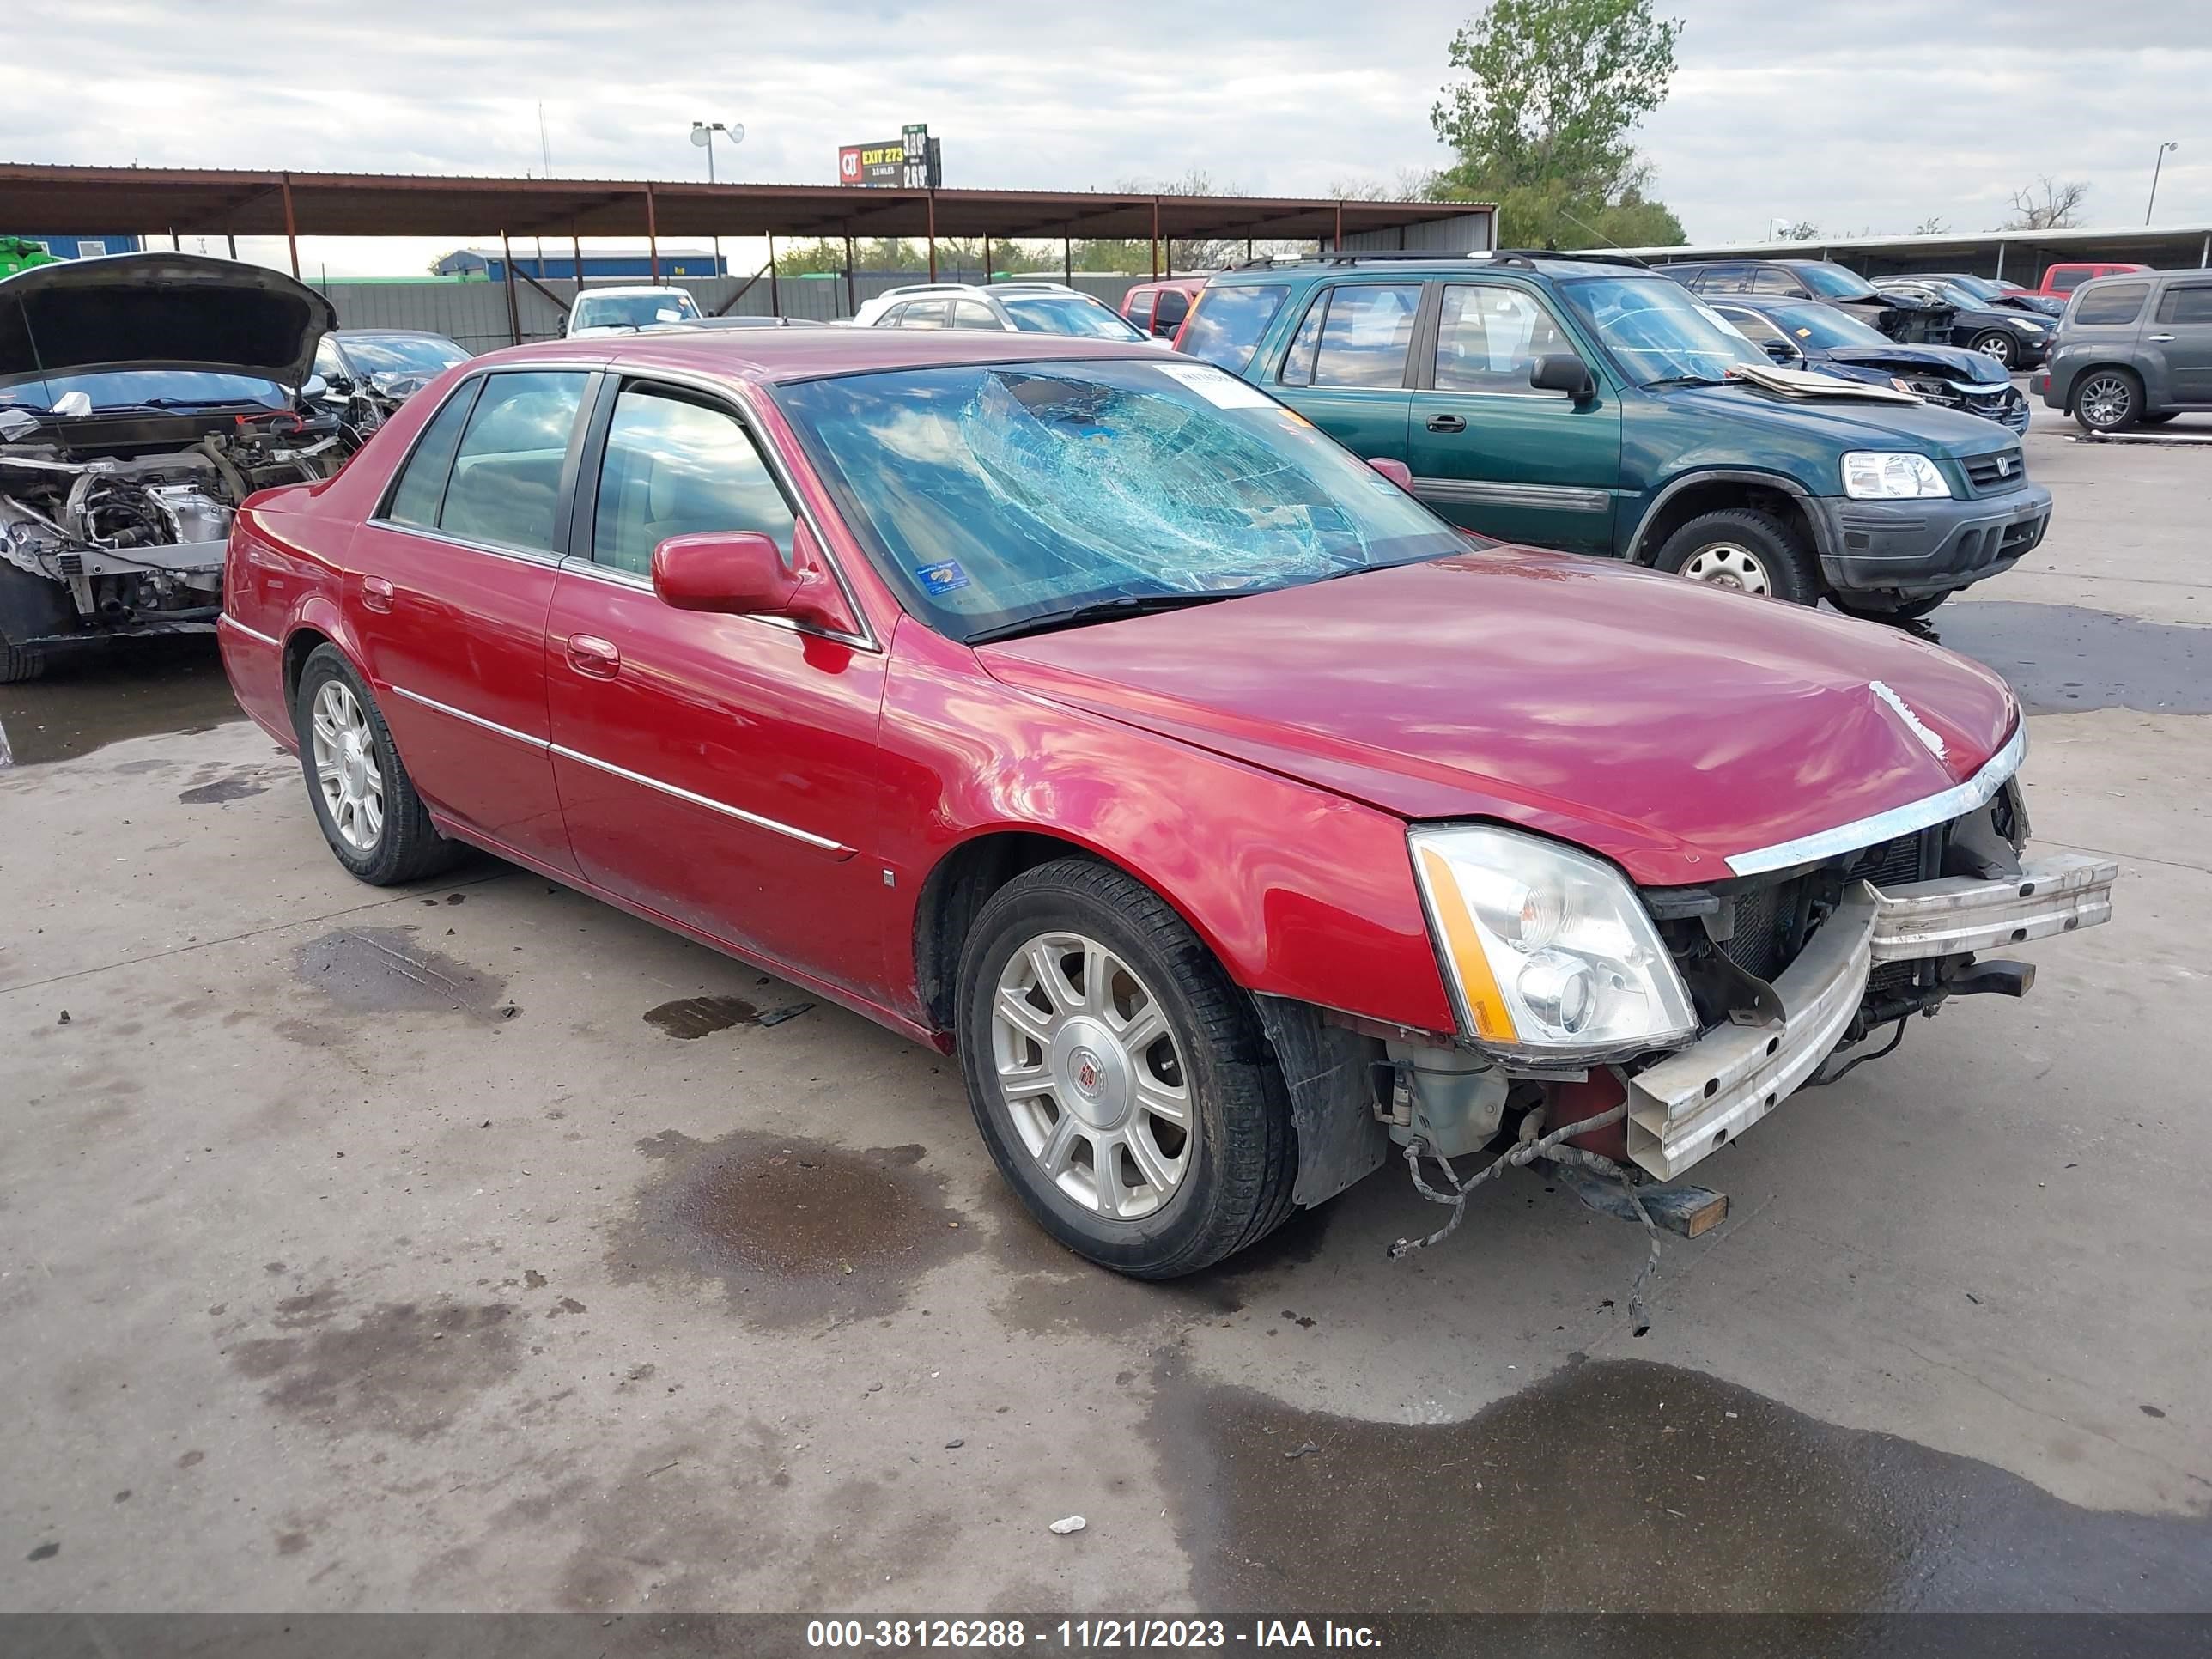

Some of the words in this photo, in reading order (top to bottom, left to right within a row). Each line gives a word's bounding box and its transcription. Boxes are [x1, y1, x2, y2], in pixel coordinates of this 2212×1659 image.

[842, 153, 858, 177] QT
[862, 149, 884, 165] EXIT
[885, 147, 903, 162] 273
